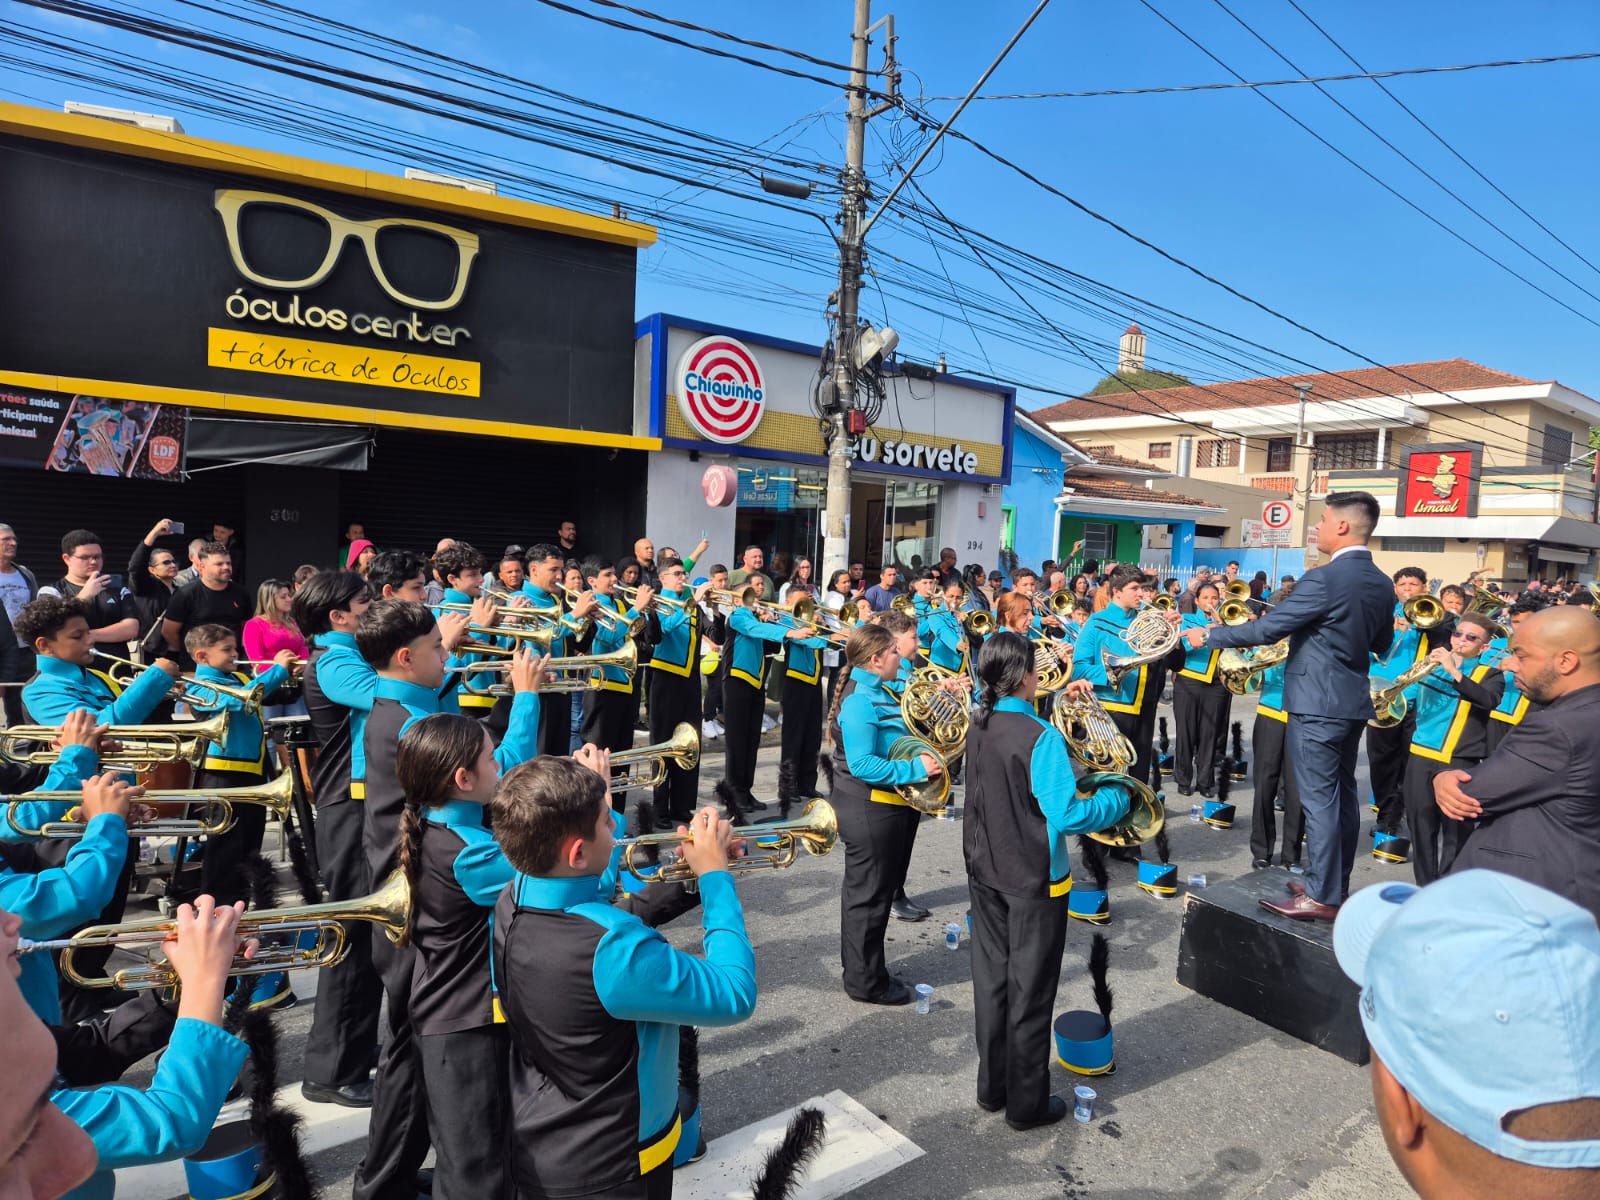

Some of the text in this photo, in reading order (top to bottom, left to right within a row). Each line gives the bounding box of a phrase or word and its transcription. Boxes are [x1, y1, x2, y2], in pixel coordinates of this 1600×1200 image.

[351, 356, 381, 380] de
[392, 353, 471, 391] Óculos
[685, 372, 763, 401] Chiquinho
[29, 397, 60, 409] saúda
[0, 408, 55, 423] ticipantes
[153, 443, 176, 457] LDF
[883, 440, 978, 475] sorvete
[1413, 498, 1460, 513] Ismael
[1270, 506, 1282, 523] E
[967, 540, 983, 551] 294
